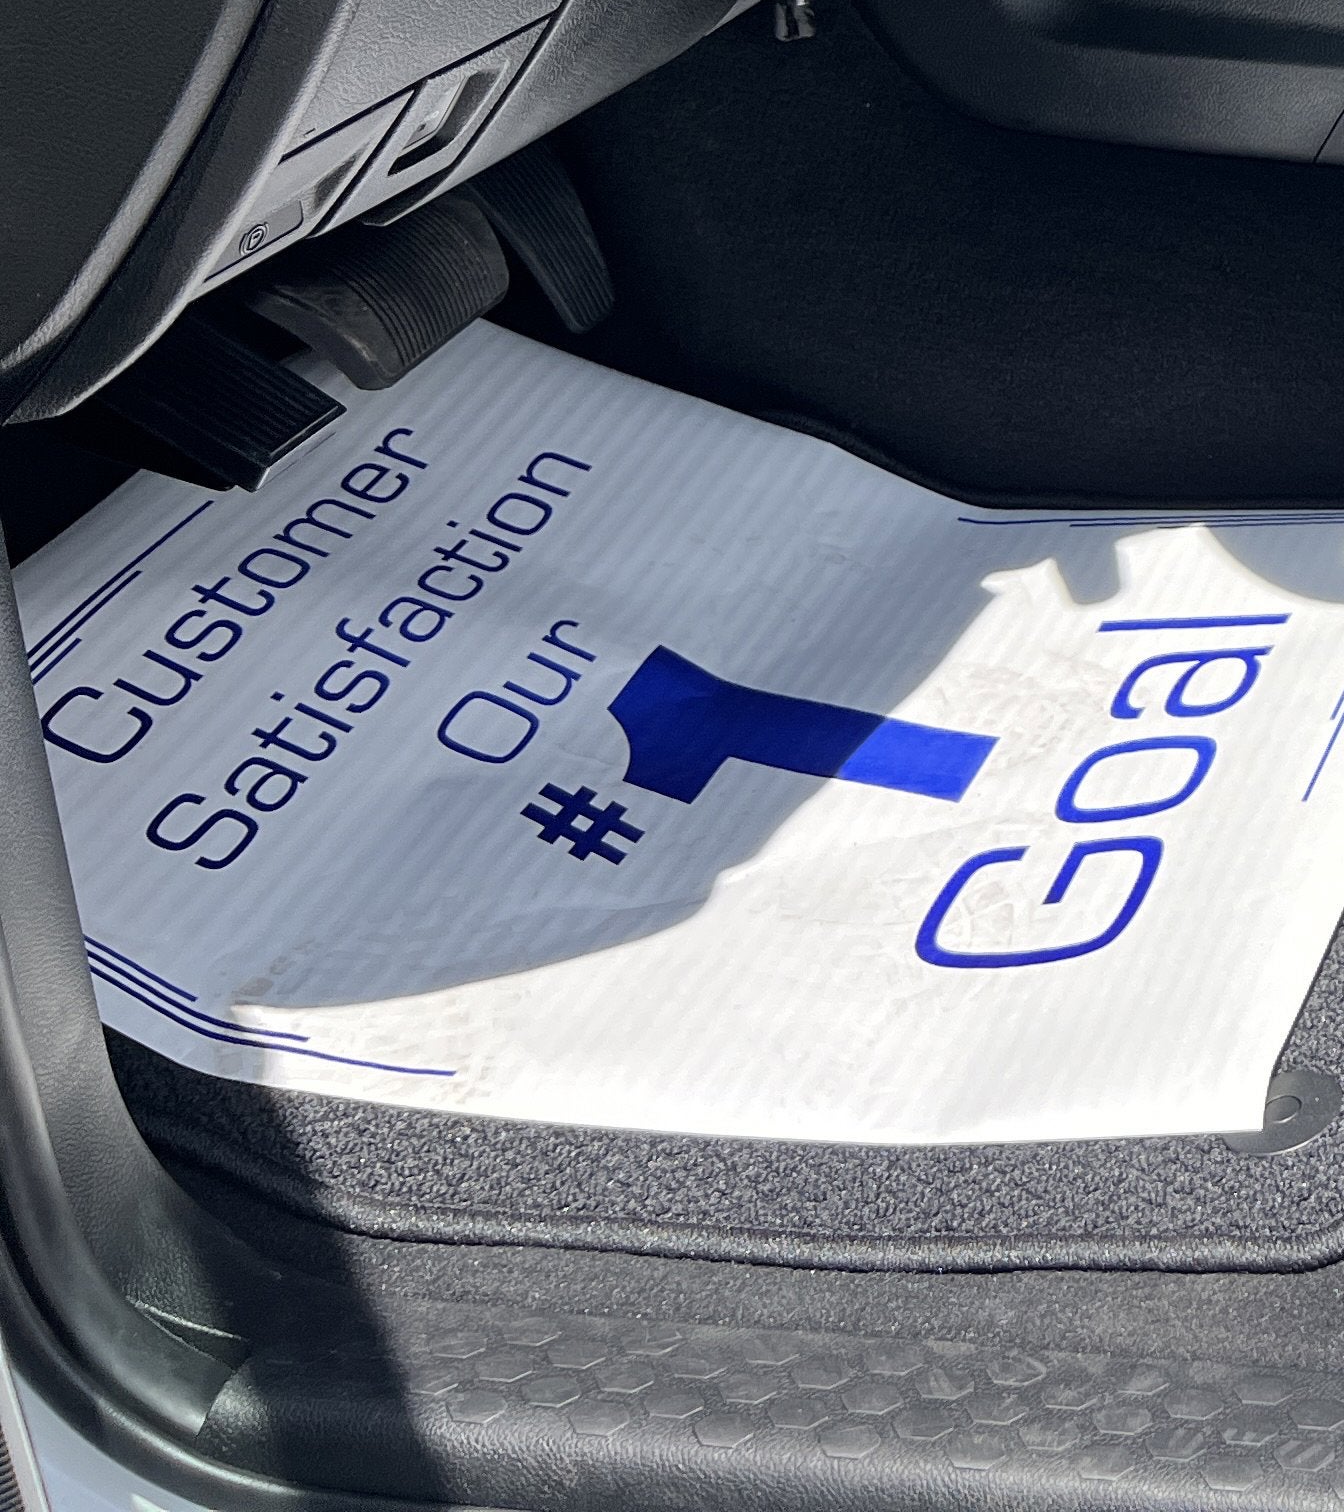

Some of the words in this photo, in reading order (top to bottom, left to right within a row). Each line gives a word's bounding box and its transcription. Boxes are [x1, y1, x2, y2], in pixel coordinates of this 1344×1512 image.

[42, 427, 430, 764] Customer
[145, 451, 594, 871] Satisfaction
[437, 618, 599, 765] Our
[915, 612, 1293, 969] Goal
